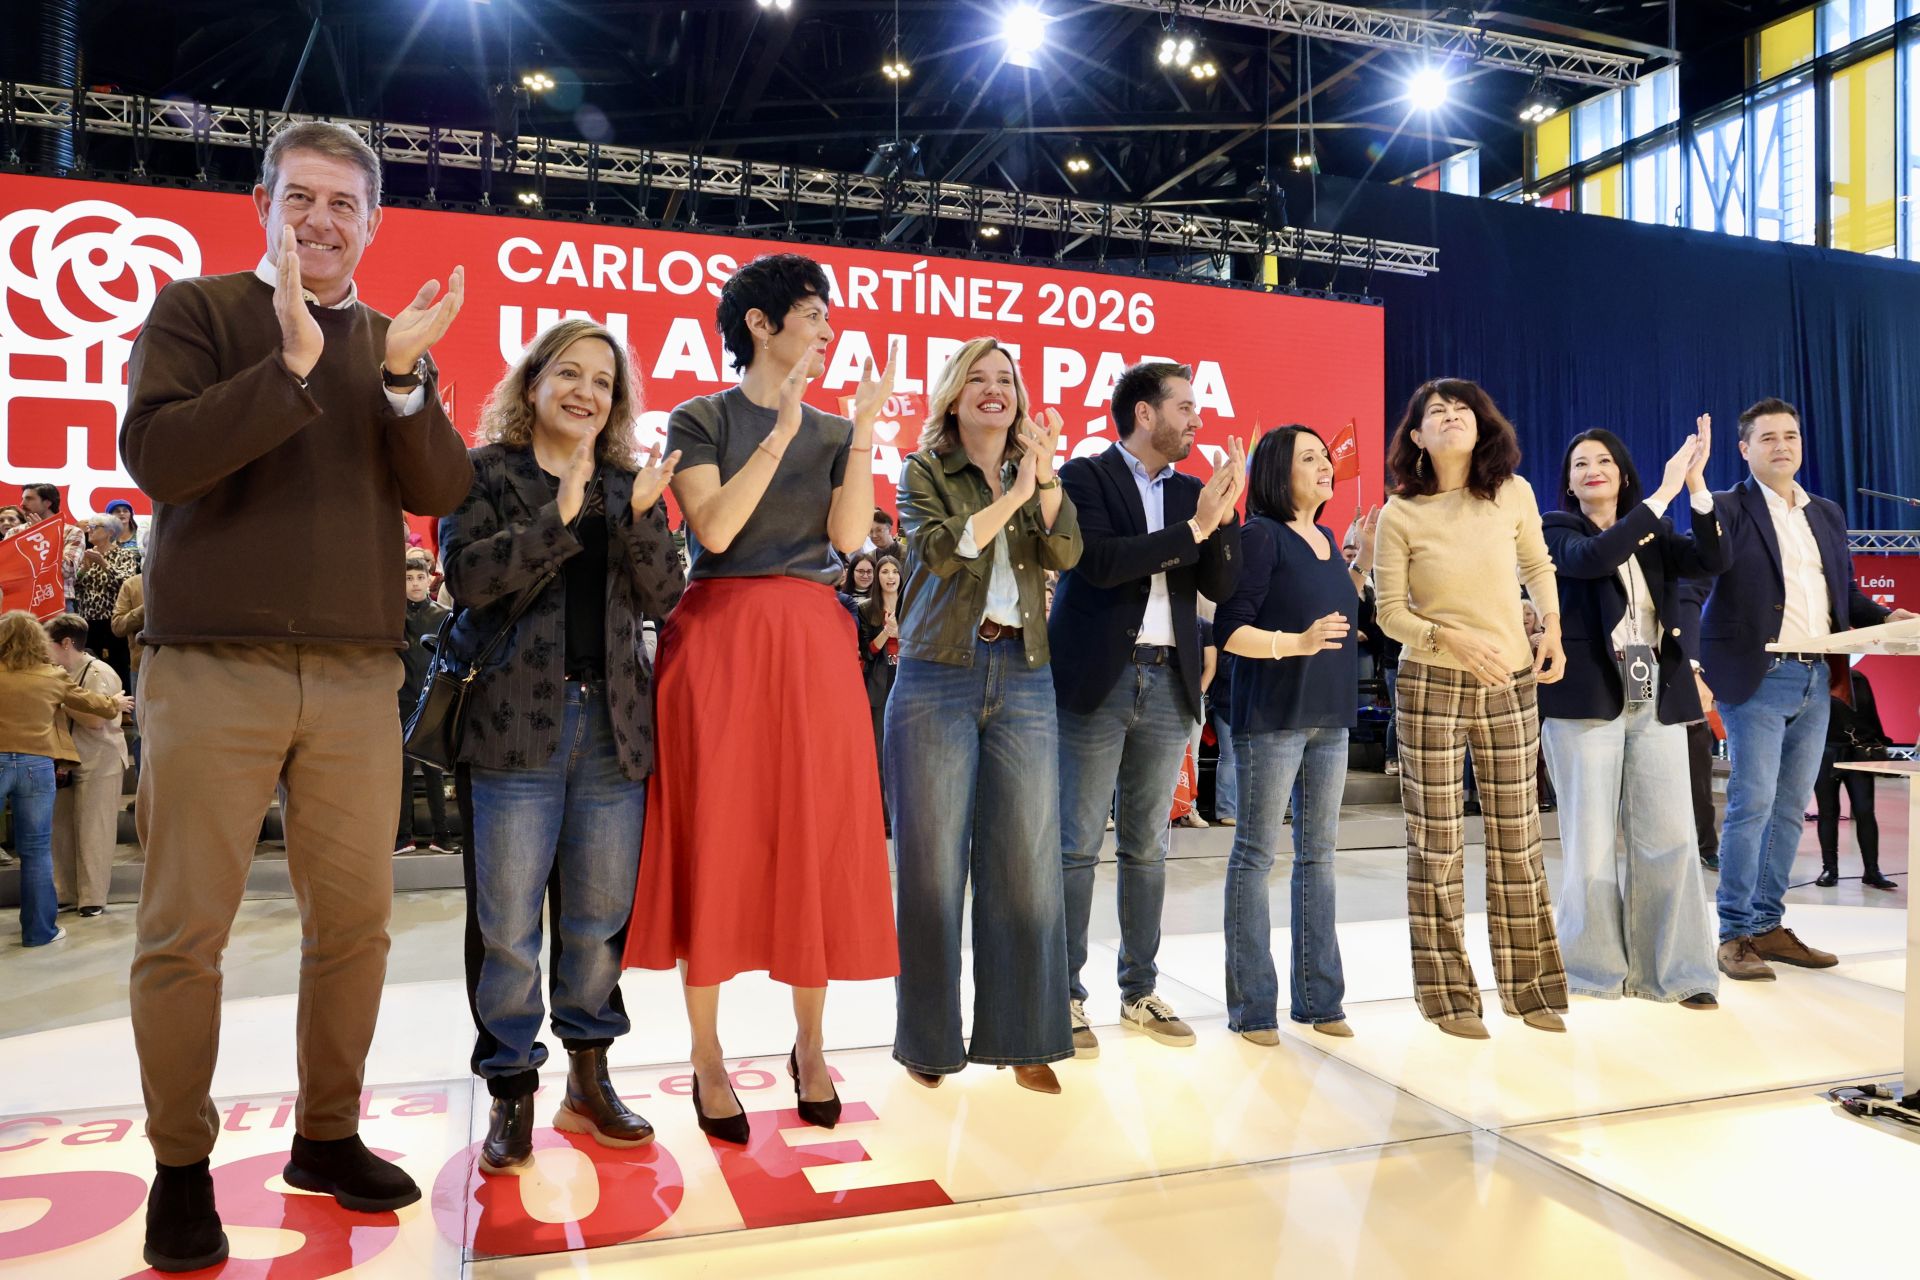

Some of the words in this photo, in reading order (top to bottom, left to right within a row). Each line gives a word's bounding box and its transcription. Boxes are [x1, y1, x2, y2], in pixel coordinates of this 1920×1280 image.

[497, 236, 738, 299] CARLOS
[819, 259, 1024, 324] ARTÍNEZ
[1037, 283, 1155, 335] 2026
[1042, 345, 1236, 418] PAA
[1861, 575, 1895, 588] León
[0, 1088, 449, 1152] Catila
